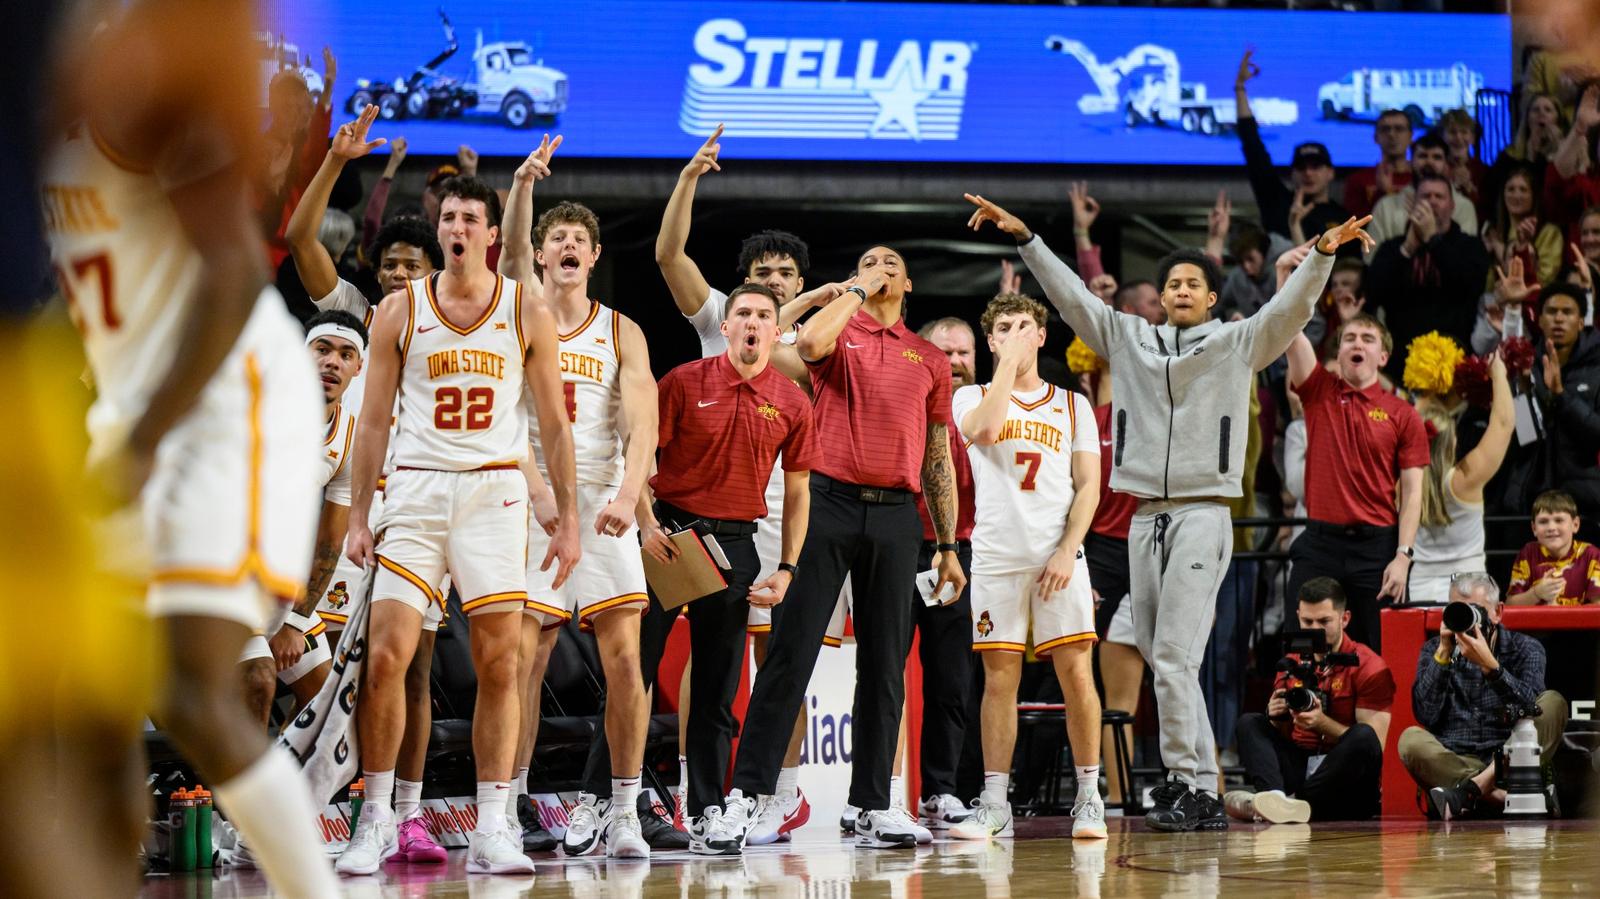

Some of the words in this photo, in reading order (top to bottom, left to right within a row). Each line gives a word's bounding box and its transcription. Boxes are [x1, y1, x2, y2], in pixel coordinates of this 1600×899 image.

[689, 18, 972, 91] STELLAR
[427, 350, 459, 380] IOWA
[462, 349, 505, 380] STATE
[560, 352, 603, 383] STATE
[434, 386, 495, 430] 22
[994, 419, 1022, 444] OWA
[1025, 421, 1063, 452] STATE
[1015, 452, 1042, 491] 7
[800, 695, 853, 765] iac
